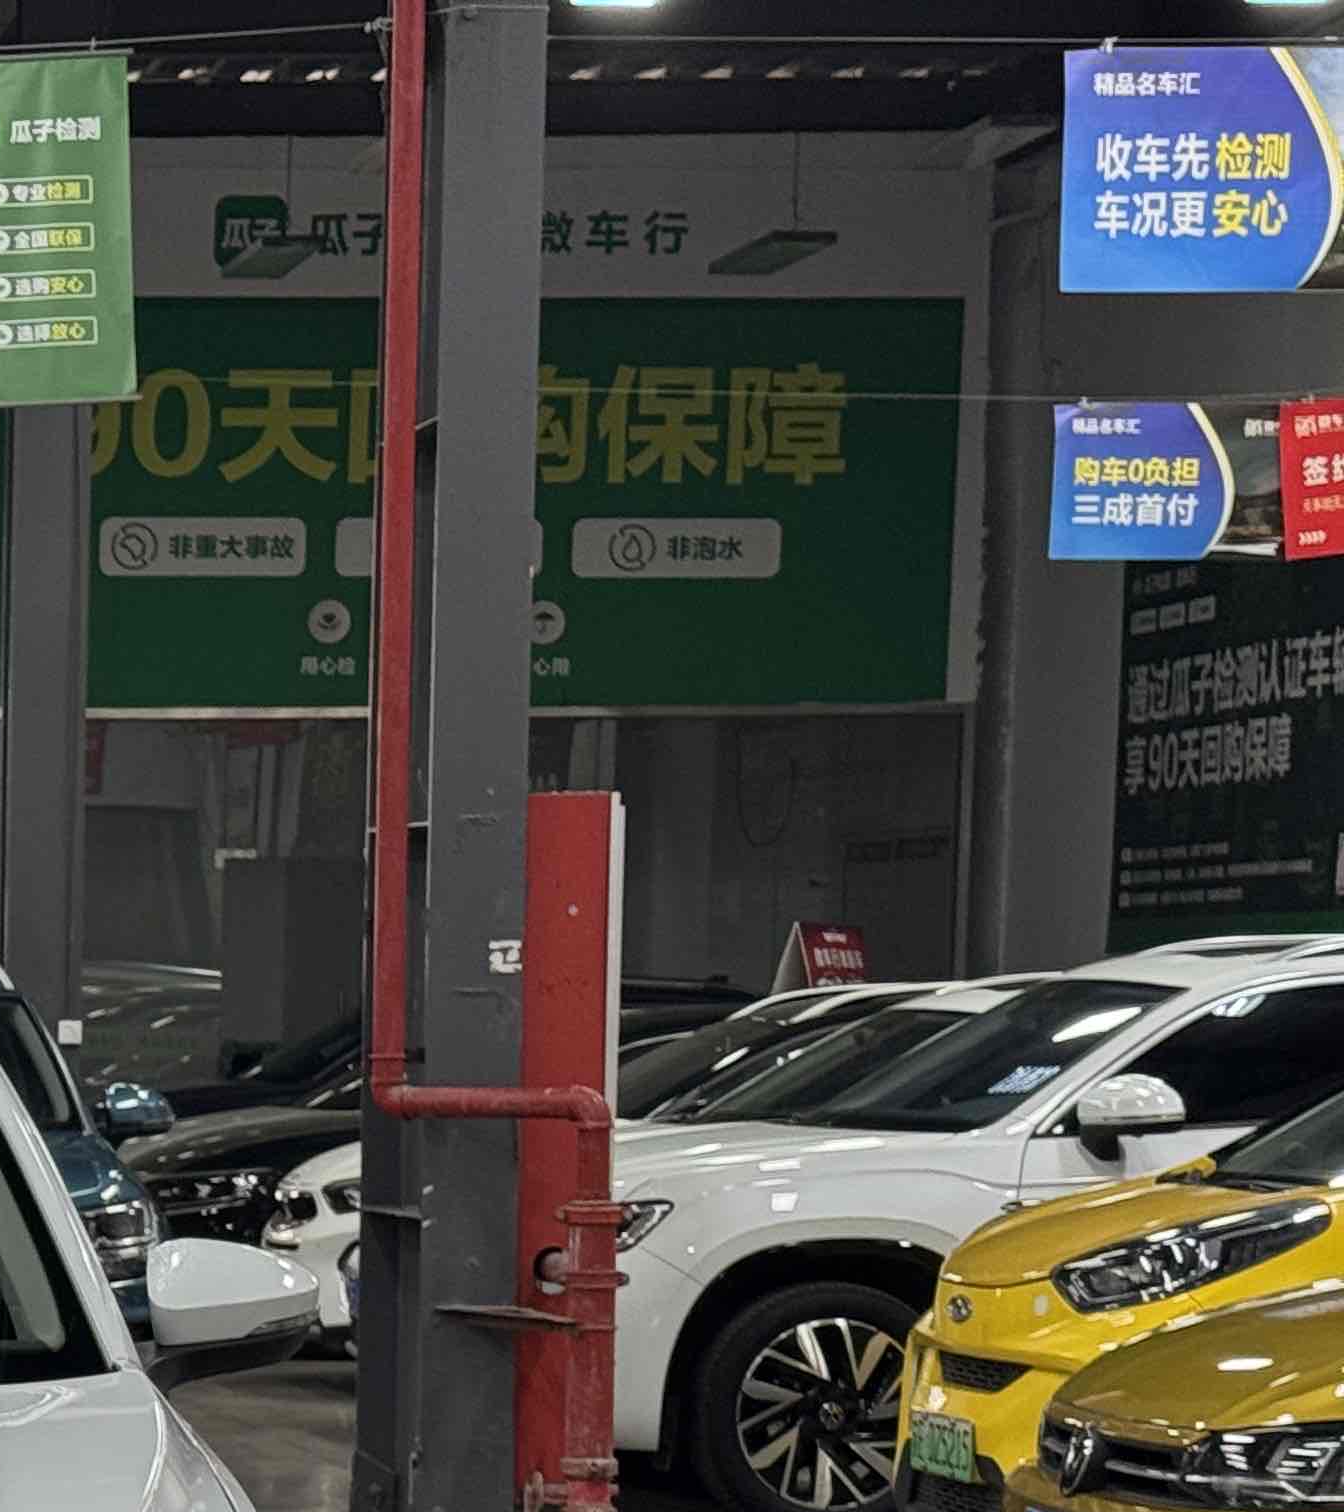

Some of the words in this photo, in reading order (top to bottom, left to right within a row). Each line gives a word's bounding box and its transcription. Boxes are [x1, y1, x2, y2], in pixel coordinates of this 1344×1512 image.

[1093, 72, 1201, 97] 精品名车汇
[10, 116, 102, 144] 瓜子检测
[1096, 131, 1292, 182] 收车先检测
[12, 181, 81, 202] 专业检测
[1094, 190, 1288, 239] 车况更安心
[1073, 457, 1200, 488] 购车0负担
[1071, 493, 1199, 527] 三成首付
[168, 533, 295, 561] 非重大事故
[666, 534, 743, 561] 非泡水
[1123, 713, 1292, 797] 享90天回购保障
